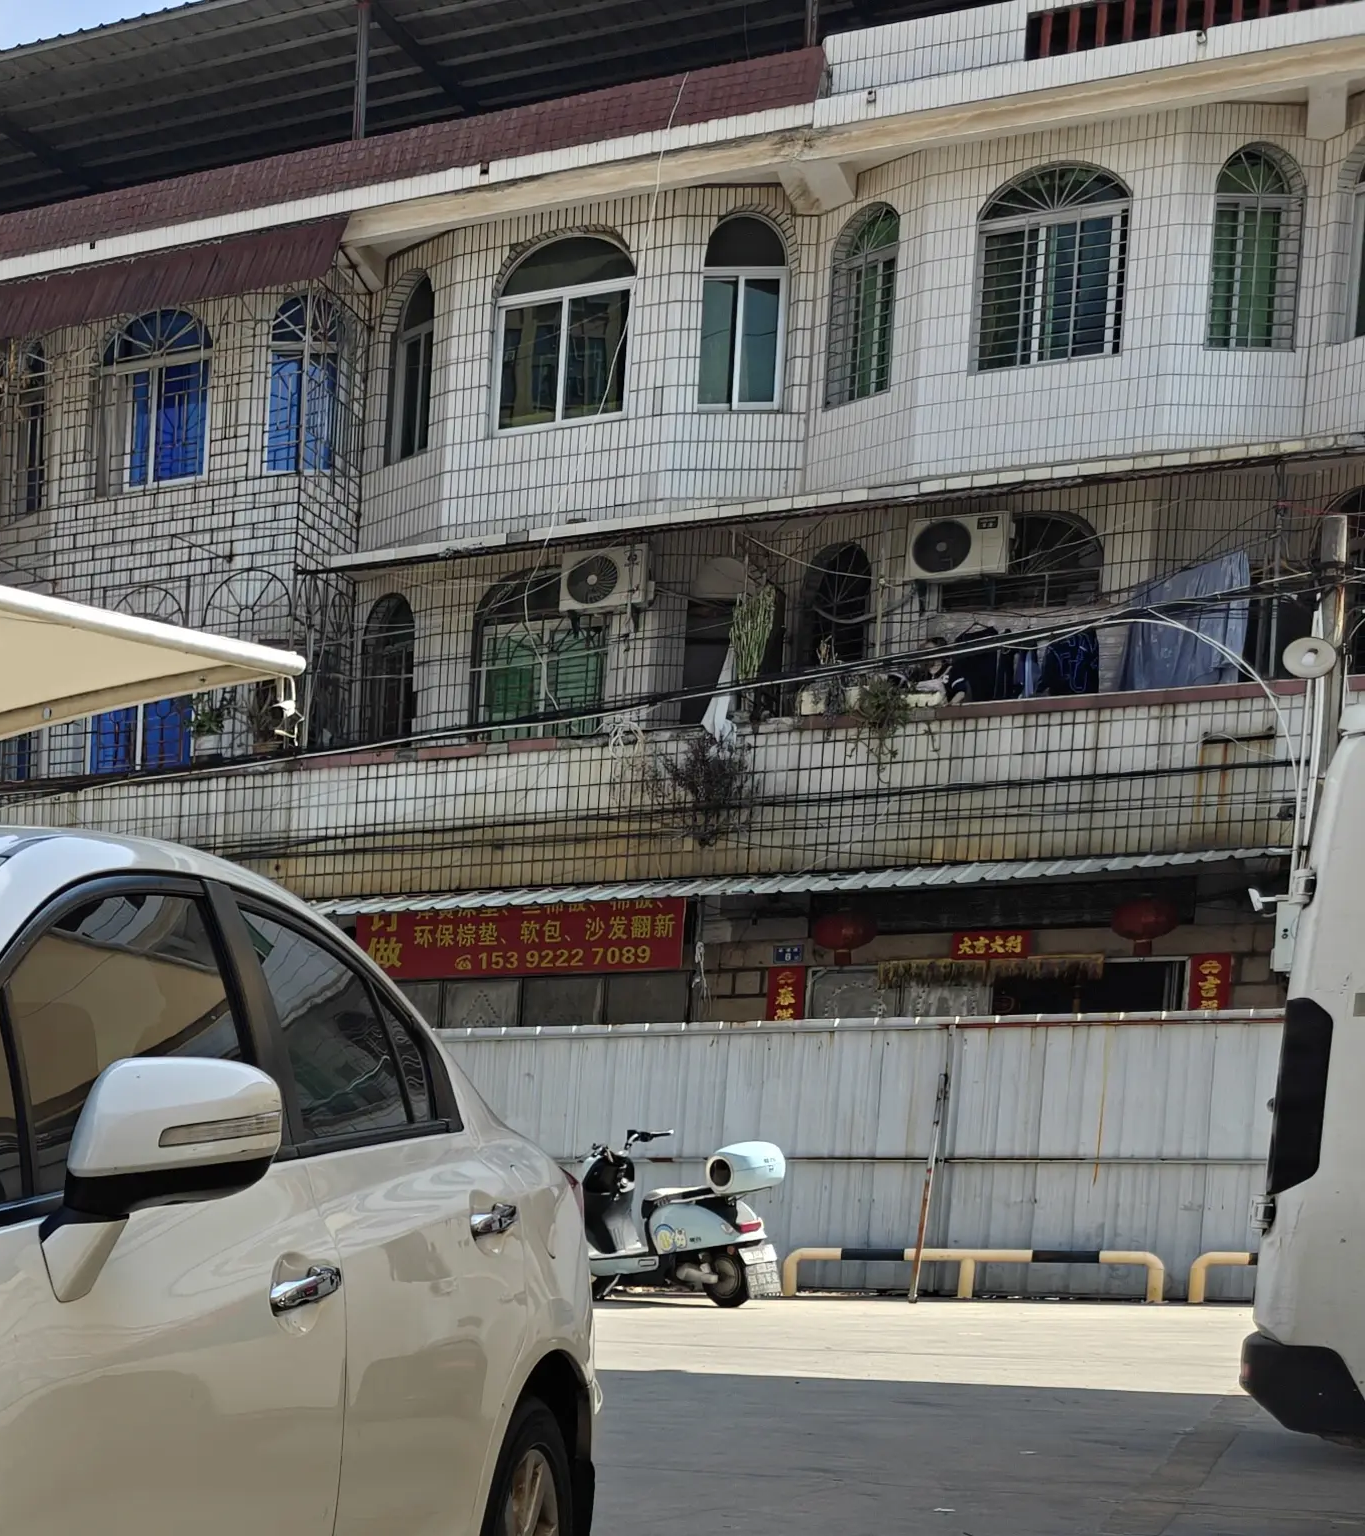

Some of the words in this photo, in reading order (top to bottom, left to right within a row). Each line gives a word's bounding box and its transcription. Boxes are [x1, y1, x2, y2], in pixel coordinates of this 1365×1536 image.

[413, 913, 676, 949] 环保棕垫、软包、沙发翻新
[477, 951, 519, 971] 153
[525, 948, 585, 969] 9222
[591, 945, 652, 966] 7089
